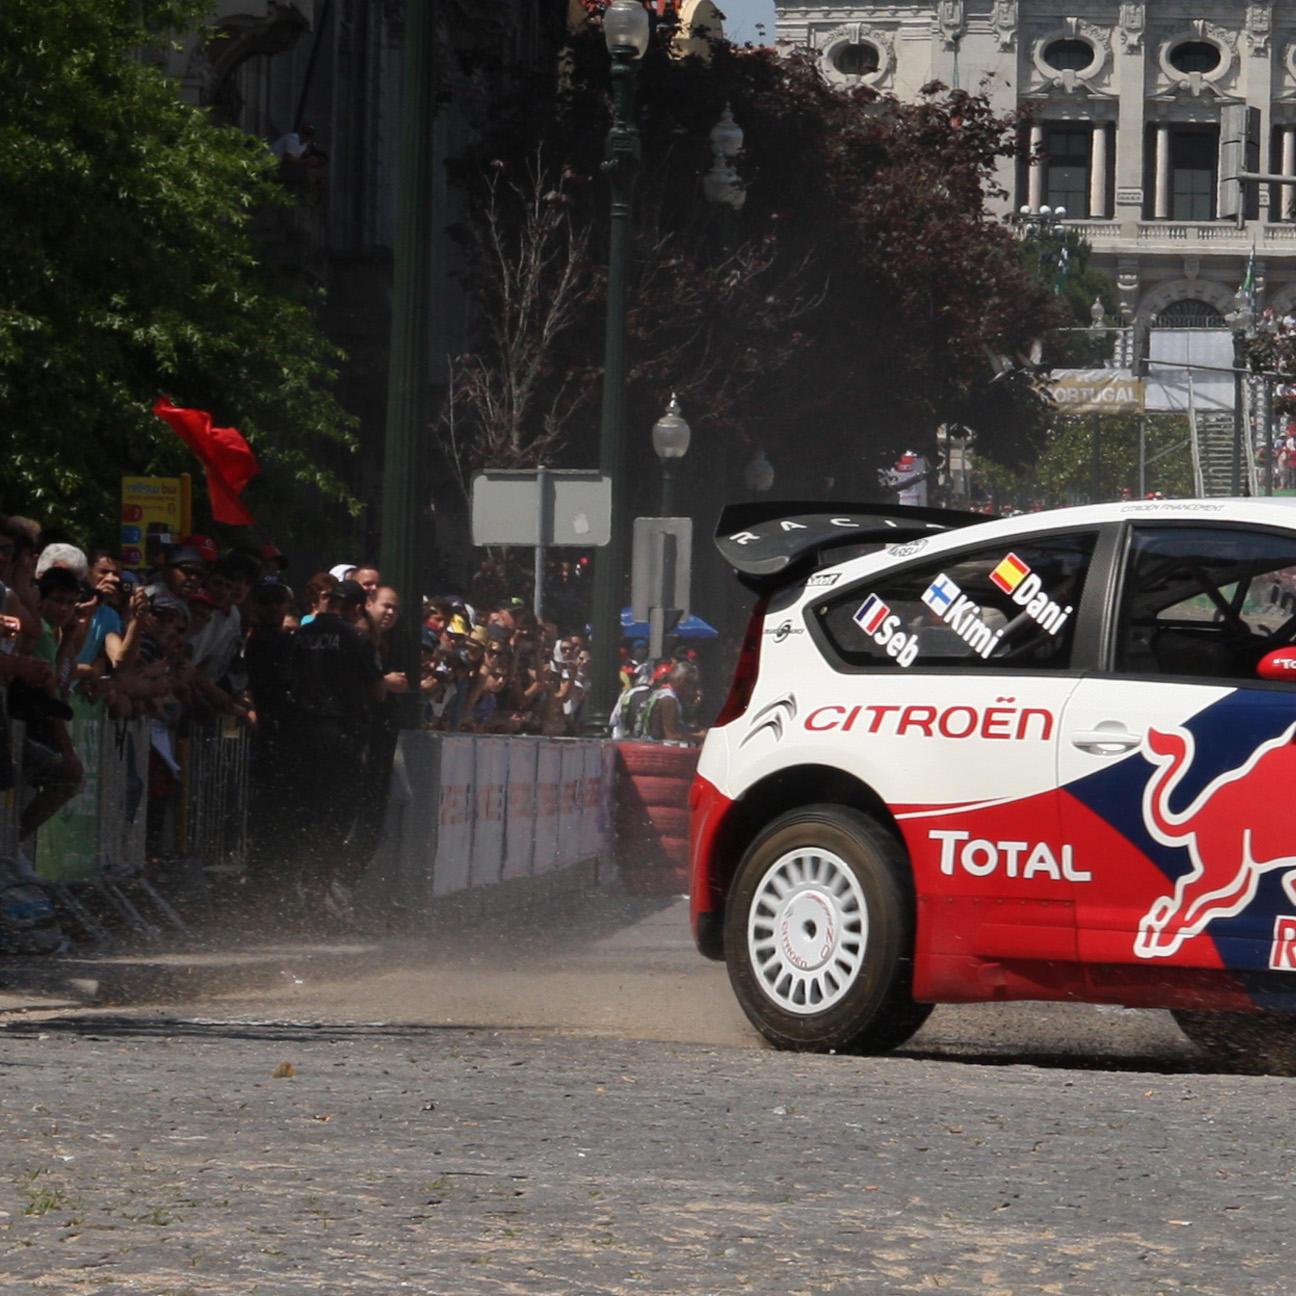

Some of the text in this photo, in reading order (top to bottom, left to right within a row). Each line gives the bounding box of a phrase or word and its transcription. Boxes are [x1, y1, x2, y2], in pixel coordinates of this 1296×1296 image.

[1049, 386, 1139, 403] ORTUGAL
[729, 517, 946, 546] RACI
[944, 594, 1005, 660] Kimi
[1011, 573, 1074, 636] Dani
[873, 614, 920, 668] Seb
[804, 696, 1054, 740] CITROËN
[928, 830, 1092, 882] TOTAL
